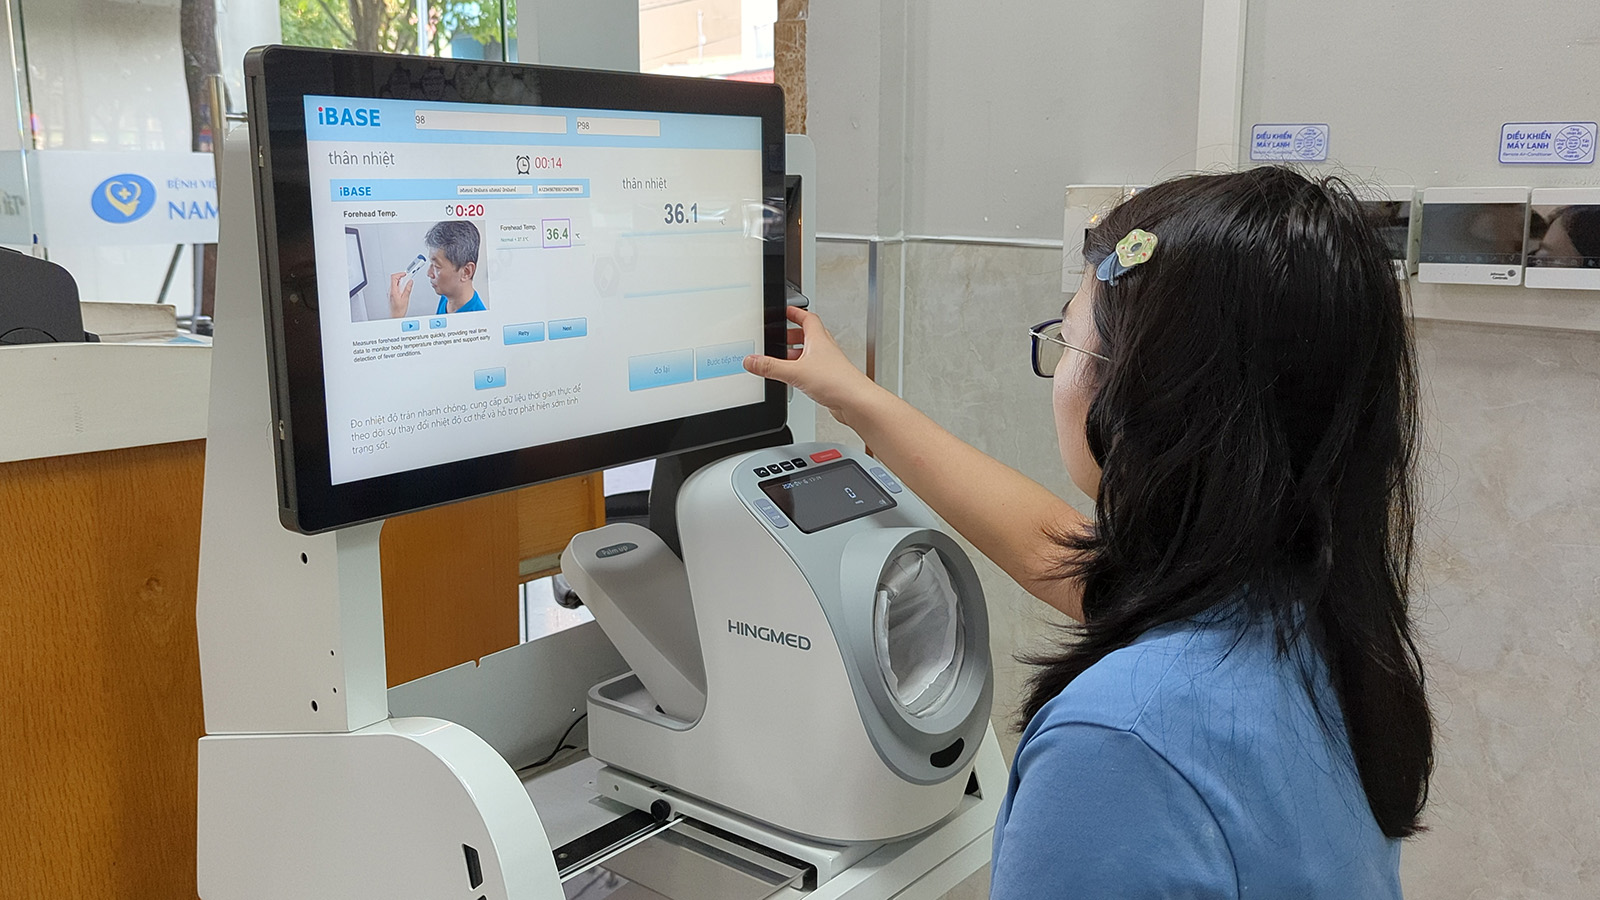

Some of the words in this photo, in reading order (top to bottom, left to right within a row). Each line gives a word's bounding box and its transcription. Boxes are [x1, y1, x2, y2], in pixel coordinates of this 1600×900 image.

[318, 107, 381, 127] iBASE
[415, 116, 426, 125] 98
[577, 121, 590, 131] P98
[1507, 140, 1526, 149] MÁY
[1526, 142, 1549, 151] LẠNH
[328, 151, 358, 166] thân
[363, 151, 395, 168] nhiệt
[534, 157, 562, 169] 00:14
[622, 177, 642, 190] thân
[645, 177, 667, 191] nhiệt
[339, 187, 372, 197] iBASE
[343, 210, 376, 218] Forehead
[377, 210, 398, 219] Temp.
[456, 204, 484, 217] 0:20
[664, 203, 698, 224] 36.1
[546, 227, 569, 241] 36.4
[378, 336, 400, 344] forehead
[447, 329, 468, 338] providing
[350, 419, 363, 428] Đo
[365, 415, 385, 427] nhiệt
[418, 406, 442, 418] nhanh
[470, 400, 488, 410] cung
[542, 389, 557, 400] gian
[351, 432, 370, 442] theo
[398, 424, 415, 435] thay
[352, 444, 374, 454] trạng
[601, 548, 618, 557] Palm
[618, 545, 628, 553] up
[728, 619, 812, 651] HINGMED
